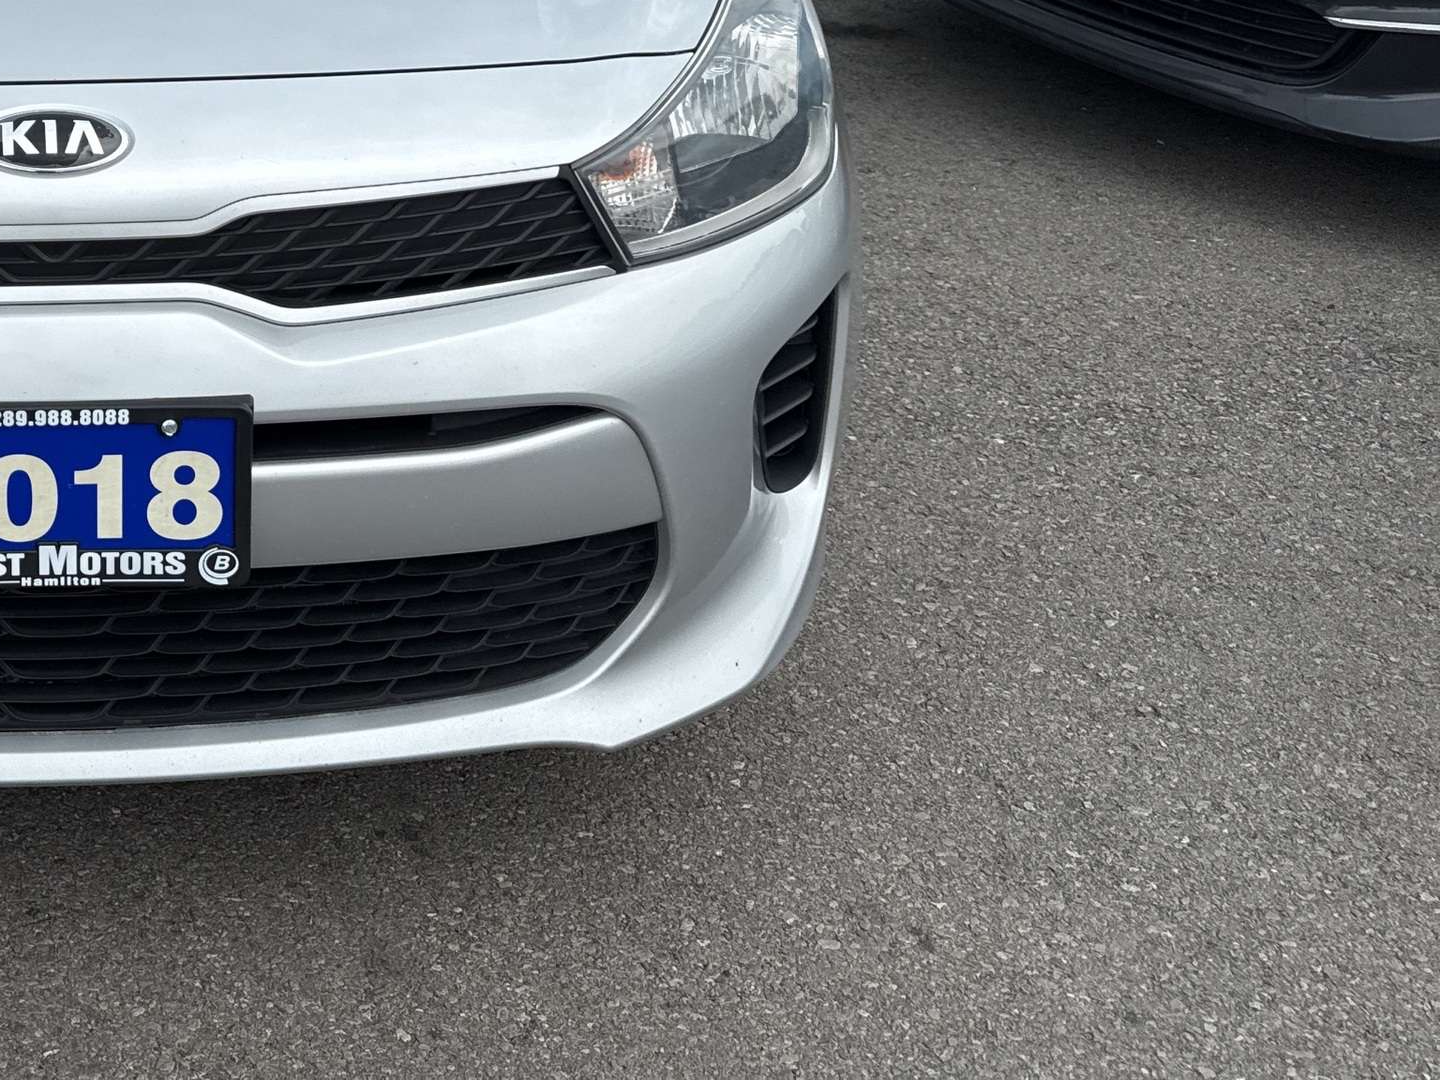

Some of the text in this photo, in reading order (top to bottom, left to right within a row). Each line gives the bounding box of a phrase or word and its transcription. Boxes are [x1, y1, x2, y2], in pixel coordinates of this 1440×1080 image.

[0, 119, 105, 156] KIA
[38, 544, 186, 577] MOTORS
[20, 576, 102, 588] Hamilton
